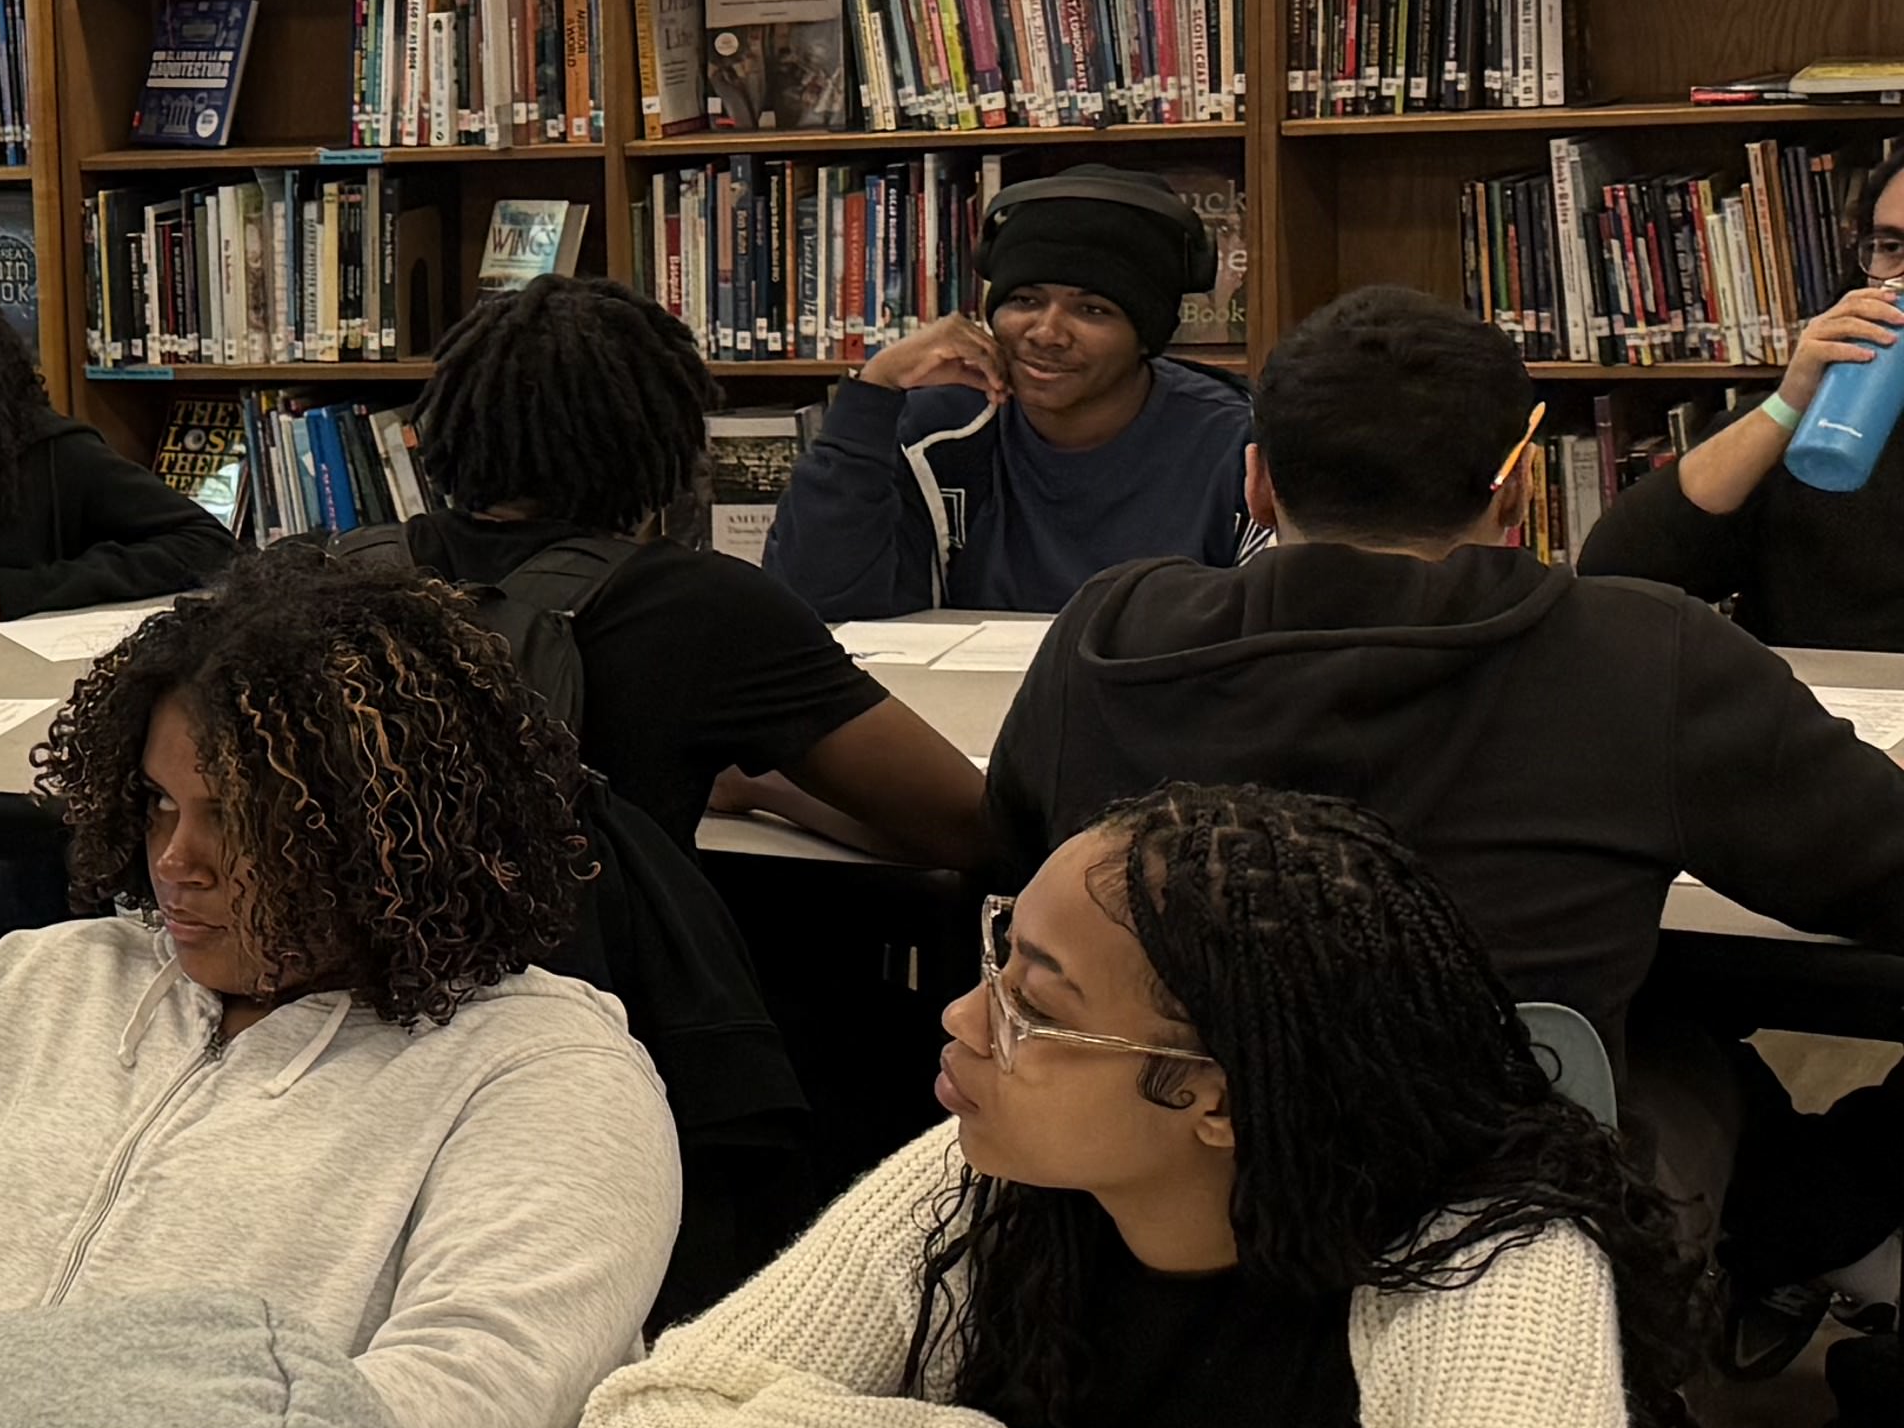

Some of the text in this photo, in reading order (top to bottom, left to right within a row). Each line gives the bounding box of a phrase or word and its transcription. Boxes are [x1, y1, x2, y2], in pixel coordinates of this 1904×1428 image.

[576, 9, 586, 54] MIRROR
[1192, 8, 1207, 51] SLOTH
[408, 46, 418, 70] BOOK
[566, 26, 578, 68] WORLD
[148, 61, 230, 78] ARQUITECTURA
[888, 188, 898, 215] OSCAR
[492, 226, 557, 257] WINGS
[669, 254, 682, 305] Basquiat
[1182, 299, 1246, 324] Book
[162, 425, 247, 455] LOST
